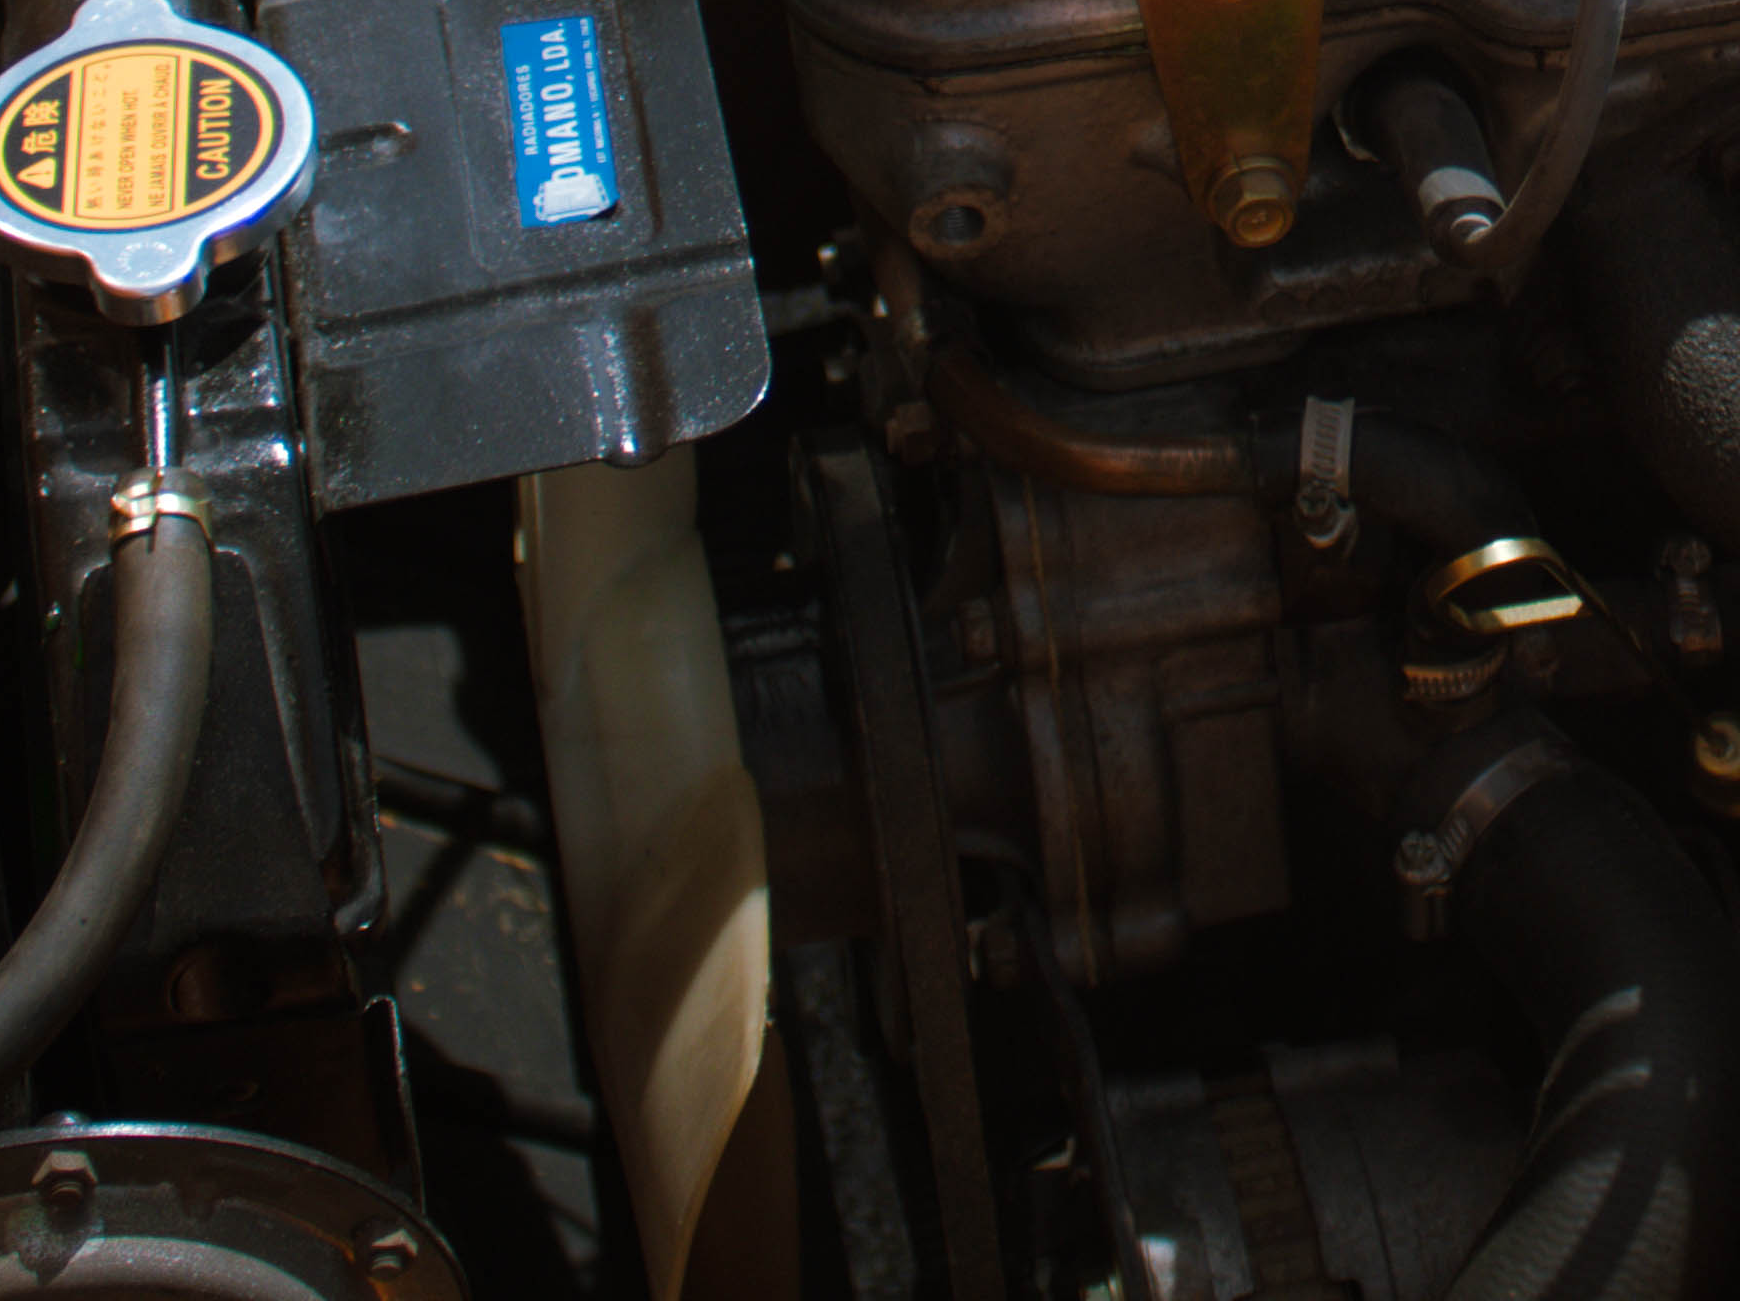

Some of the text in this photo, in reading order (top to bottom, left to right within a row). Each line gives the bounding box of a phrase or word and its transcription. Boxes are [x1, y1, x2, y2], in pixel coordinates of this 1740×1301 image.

[539, 22, 570, 72] LDA.
[20, 99, 61, 155] 危険
[150, 100, 169, 108] À
[195, 78, 233, 180] CAUTION
[515, 65, 538, 155] RADIADORES
[116, 88, 139, 209] NEVER OPEN WHEN HOT.
[152, 111, 169, 149] OUVRIR
[151, 153, 167, 190] JAMAIS
[150, 191, 166, 207] NE
